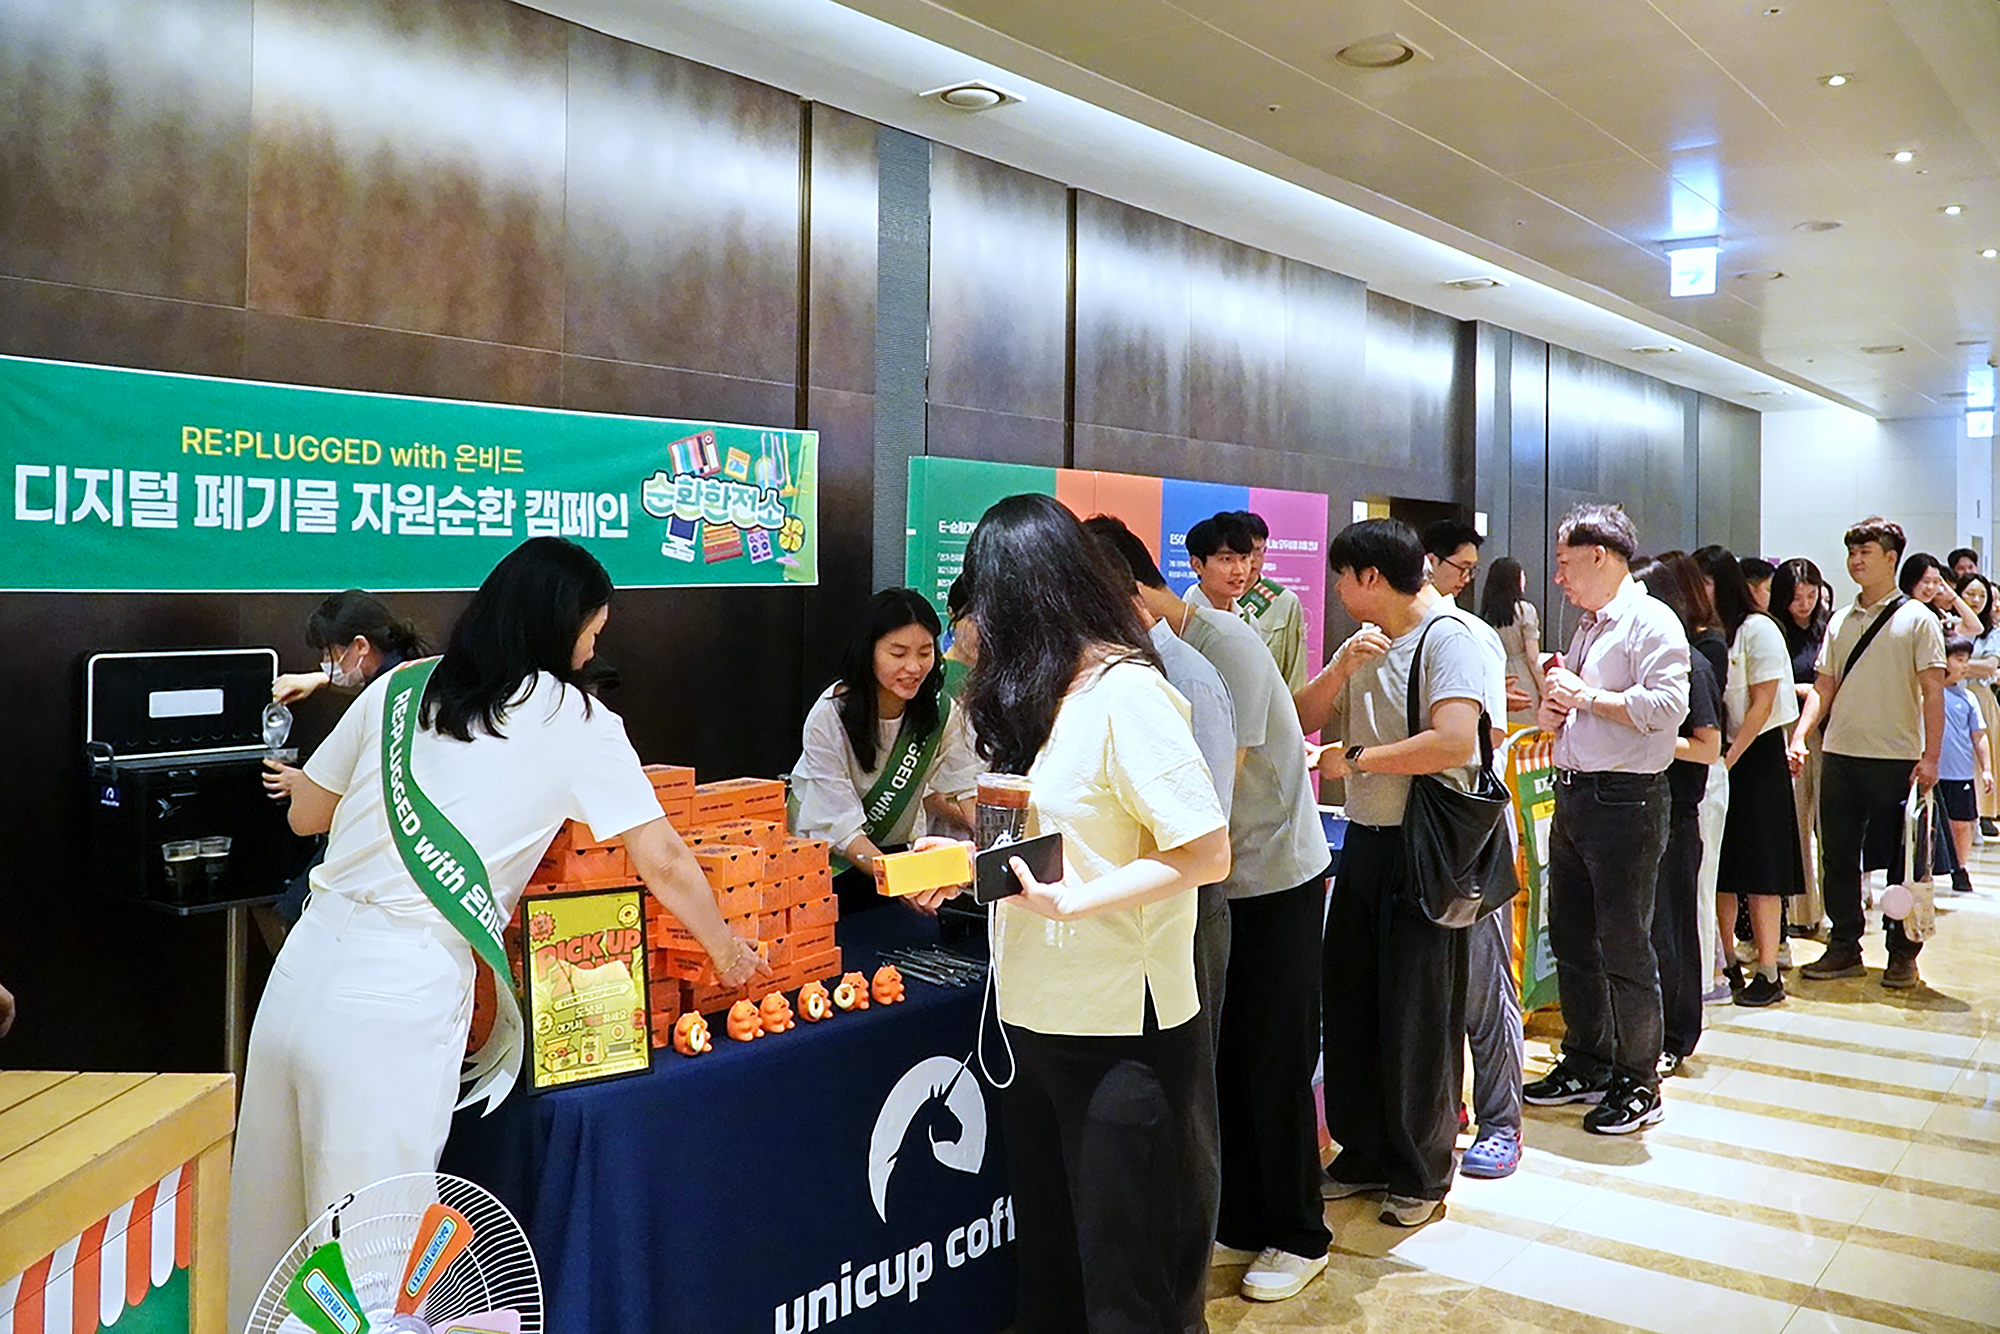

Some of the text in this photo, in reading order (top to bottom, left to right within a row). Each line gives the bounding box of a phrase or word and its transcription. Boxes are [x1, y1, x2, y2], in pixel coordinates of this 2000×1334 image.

[181, 425, 525, 475] RE:PLUGGED with 온비드
[14, 464, 630, 540] 디지털 폐기물 자원순환 캠페인
[388, 686, 422, 838] RE:PLUGGED
[414, 834, 465, 895] with
[536, 928, 642, 982] PICK UP
[774, 1239, 934, 1334] unicup
